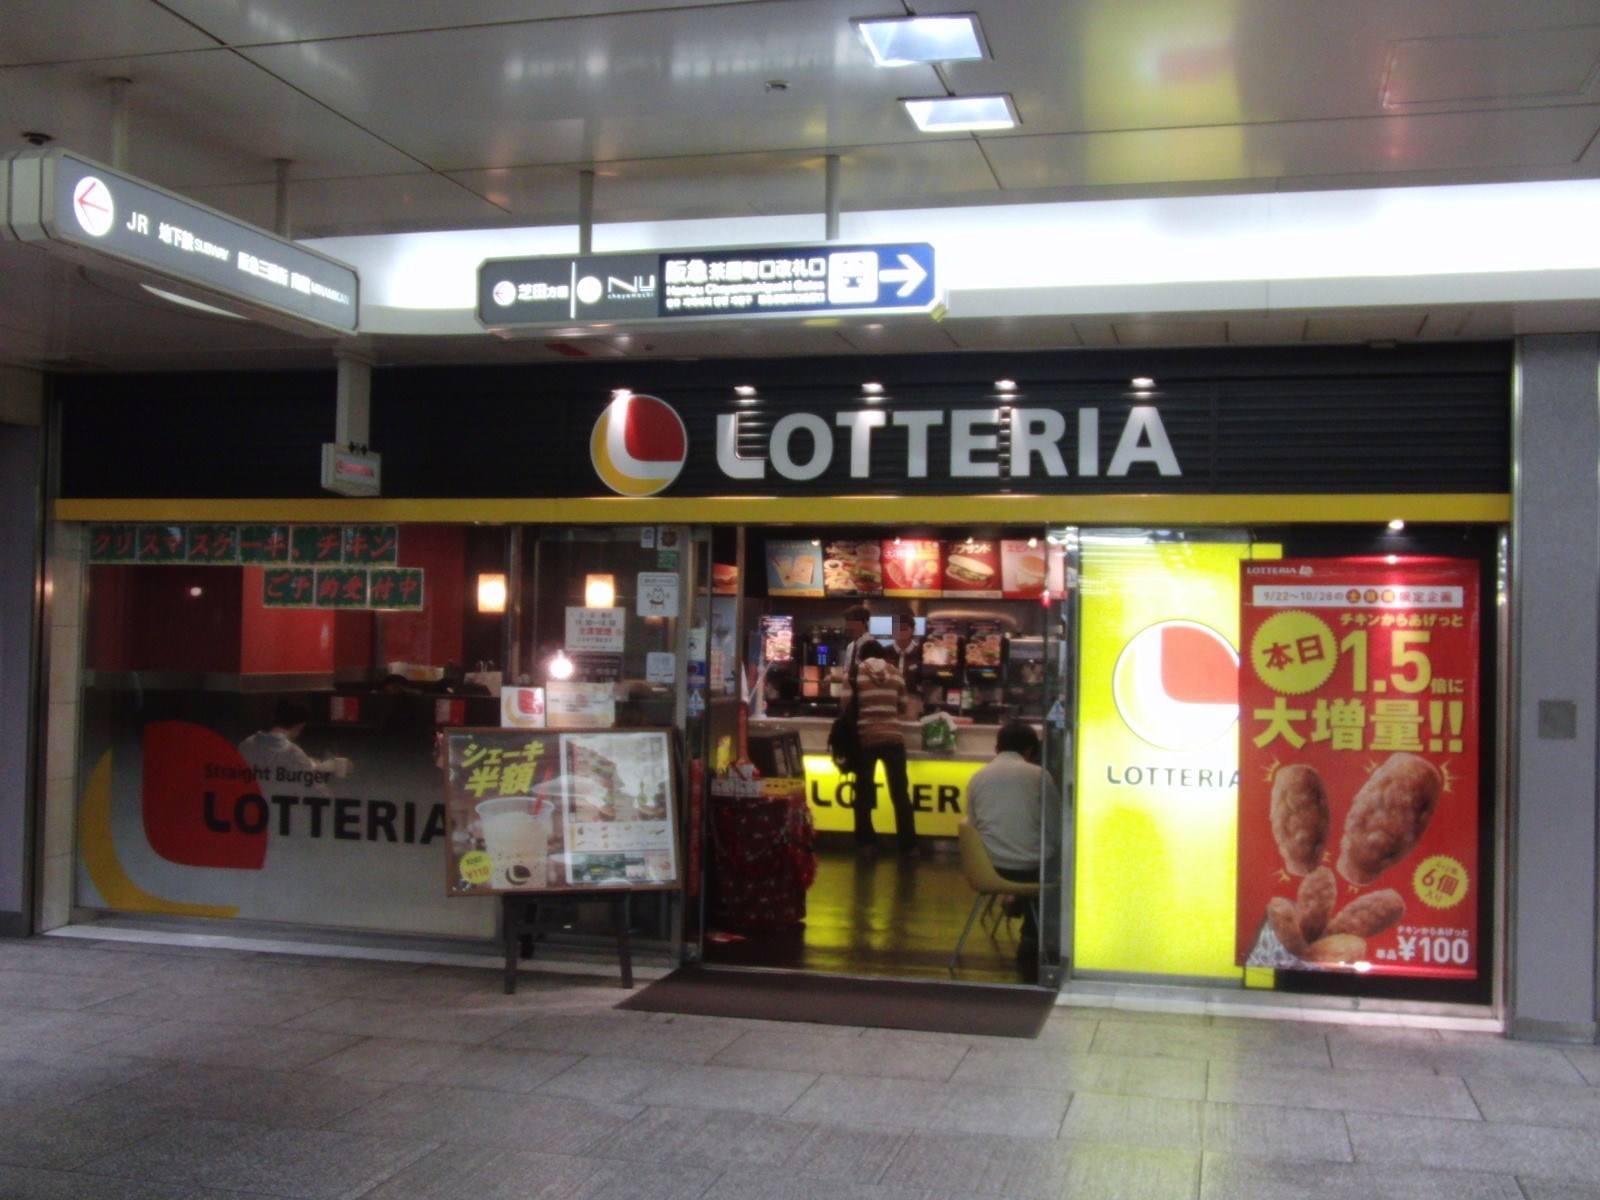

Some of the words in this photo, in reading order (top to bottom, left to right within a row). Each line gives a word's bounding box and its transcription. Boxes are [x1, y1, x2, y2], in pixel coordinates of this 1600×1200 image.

[126, 211, 149, 236] JR
[607, 292, 654, 300] chayamachi
[715, 405, 1183, 481] LOTTERIA
[1246, 566, 1297, 575] LOTTERIA
[267, 573, 422, 601] ご予約受付中
[1340, 613, 1464, 627] チキンからあげっと
[1262, 633, 1326, 671] 本日
[460, 740, 546, 768] シェーキ
[204, 762, 272, 783] Straight
[275, 766, 333, 787] Burger
[463, 761, 538, 798] 半額
[1106, 764, 1240, 788] LOTTERIA
[204, 790, 447, 845] LOTTERIA
[1421, 868, 1460, 897] 6個
[1397, 936, 1470, 965] ¥100
